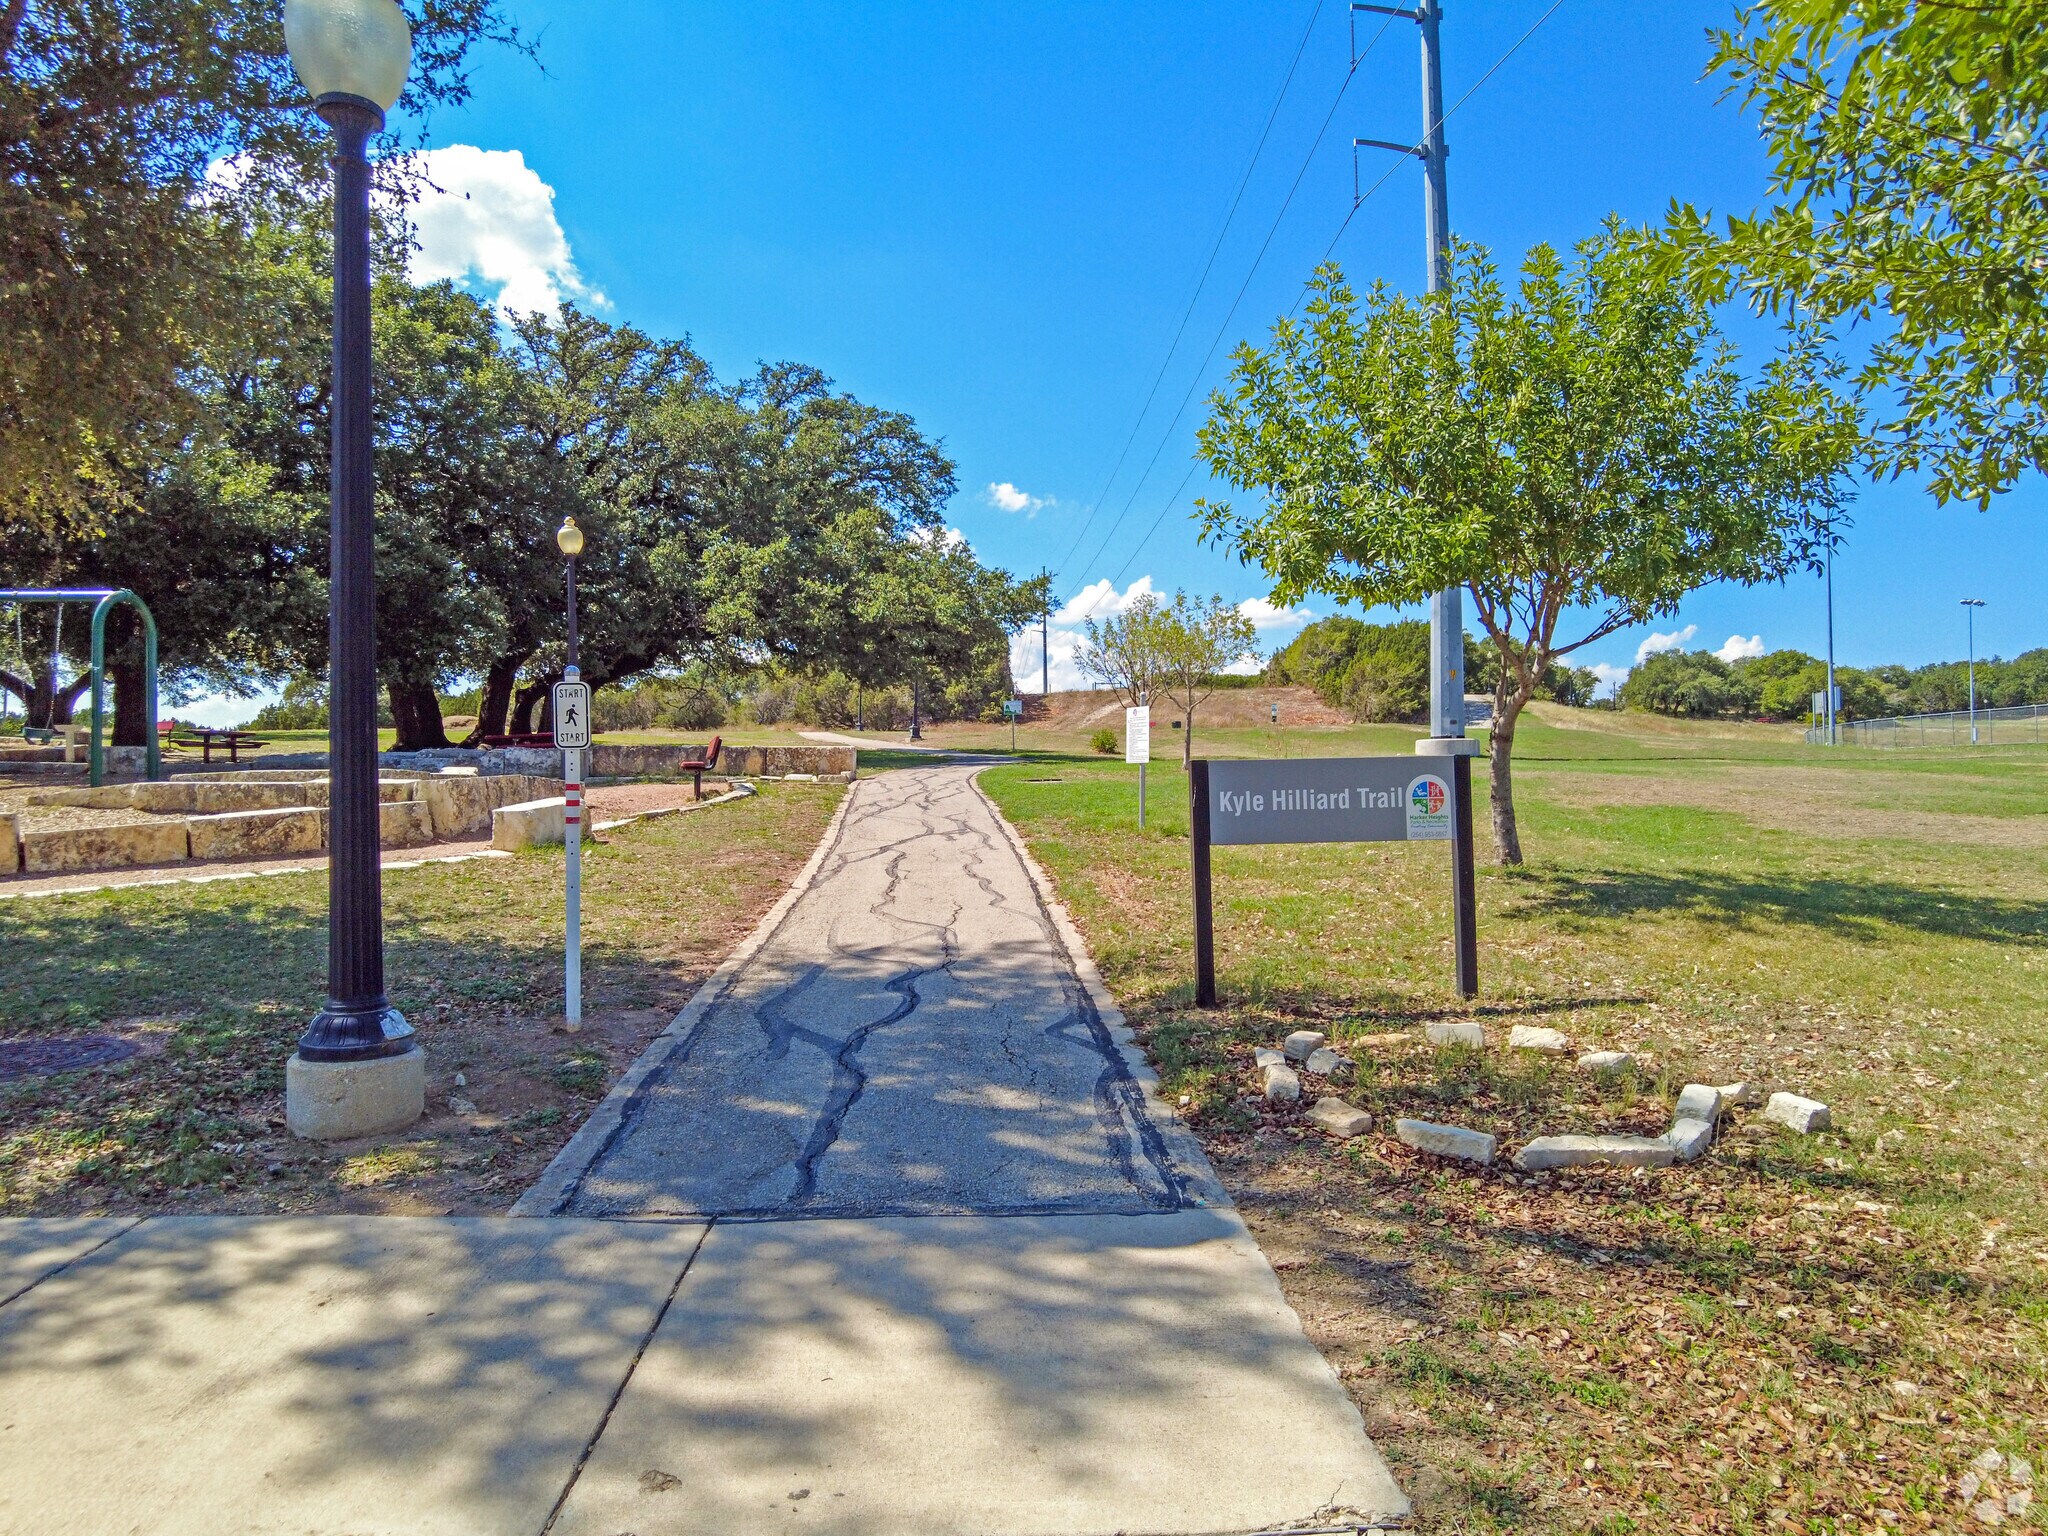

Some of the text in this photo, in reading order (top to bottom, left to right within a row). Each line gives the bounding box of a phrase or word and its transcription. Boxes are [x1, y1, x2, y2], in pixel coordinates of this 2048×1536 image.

[559, 689, 583, 698] START
[560, 733, 584, 742] START
[1219, 786, 1403, 817] Kyle Hilliard Trail
